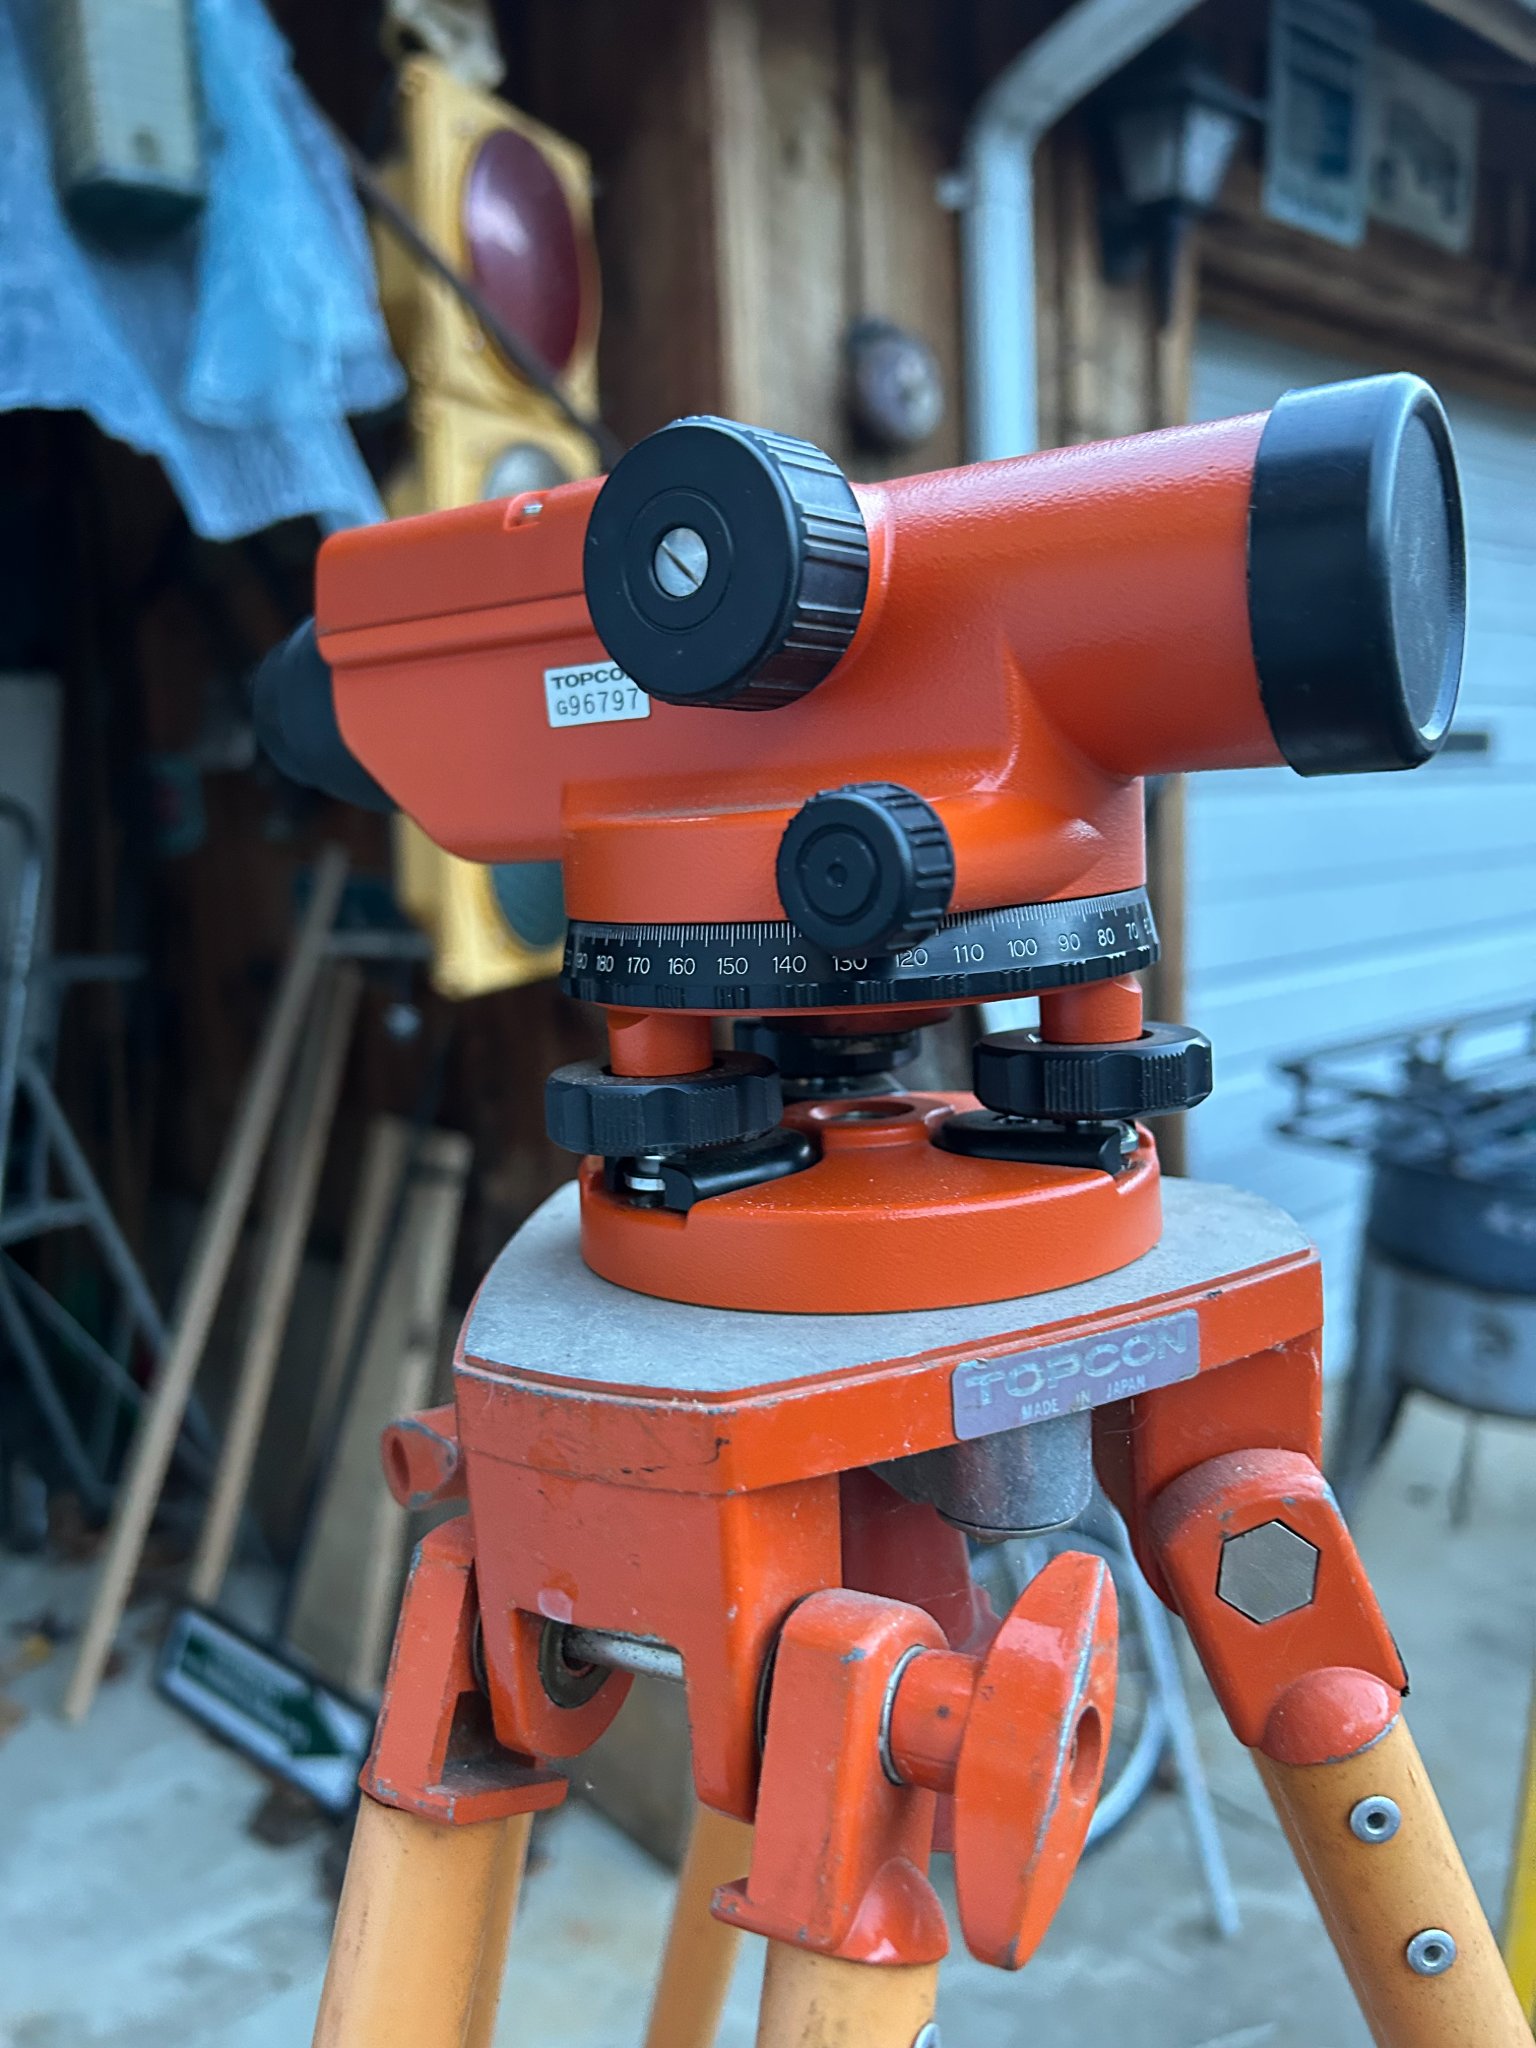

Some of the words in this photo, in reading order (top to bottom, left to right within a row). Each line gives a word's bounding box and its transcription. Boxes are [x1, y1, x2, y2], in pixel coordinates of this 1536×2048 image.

[551, 667, 629, 689] TOPCO
[556, 688, 638, 716] G96797
[596, 955, 614, 972] 180
[628, 957, 651, 974] 170
[668, 957, 695, 975] 160
[717, 957, 748, 975] 150
[772, 955, 807, 974] 140
[896, 948, 928, 968] 120
[953, 943, 984, 963] 110
[1007, 938, 1038, 957] 100
[1058, 933, 1080, 952] 90
[1097, 927, 1115, 946] 80
[1125, 922, 1138, 940] 70
[964, 1323, 1188, 1407] TOPCON
[1021, 1398, 1060, 1420] MADE
[1075, 1389, 1091, 1405] IN
[1106, 1374, 1147, 1399] JAPAN
